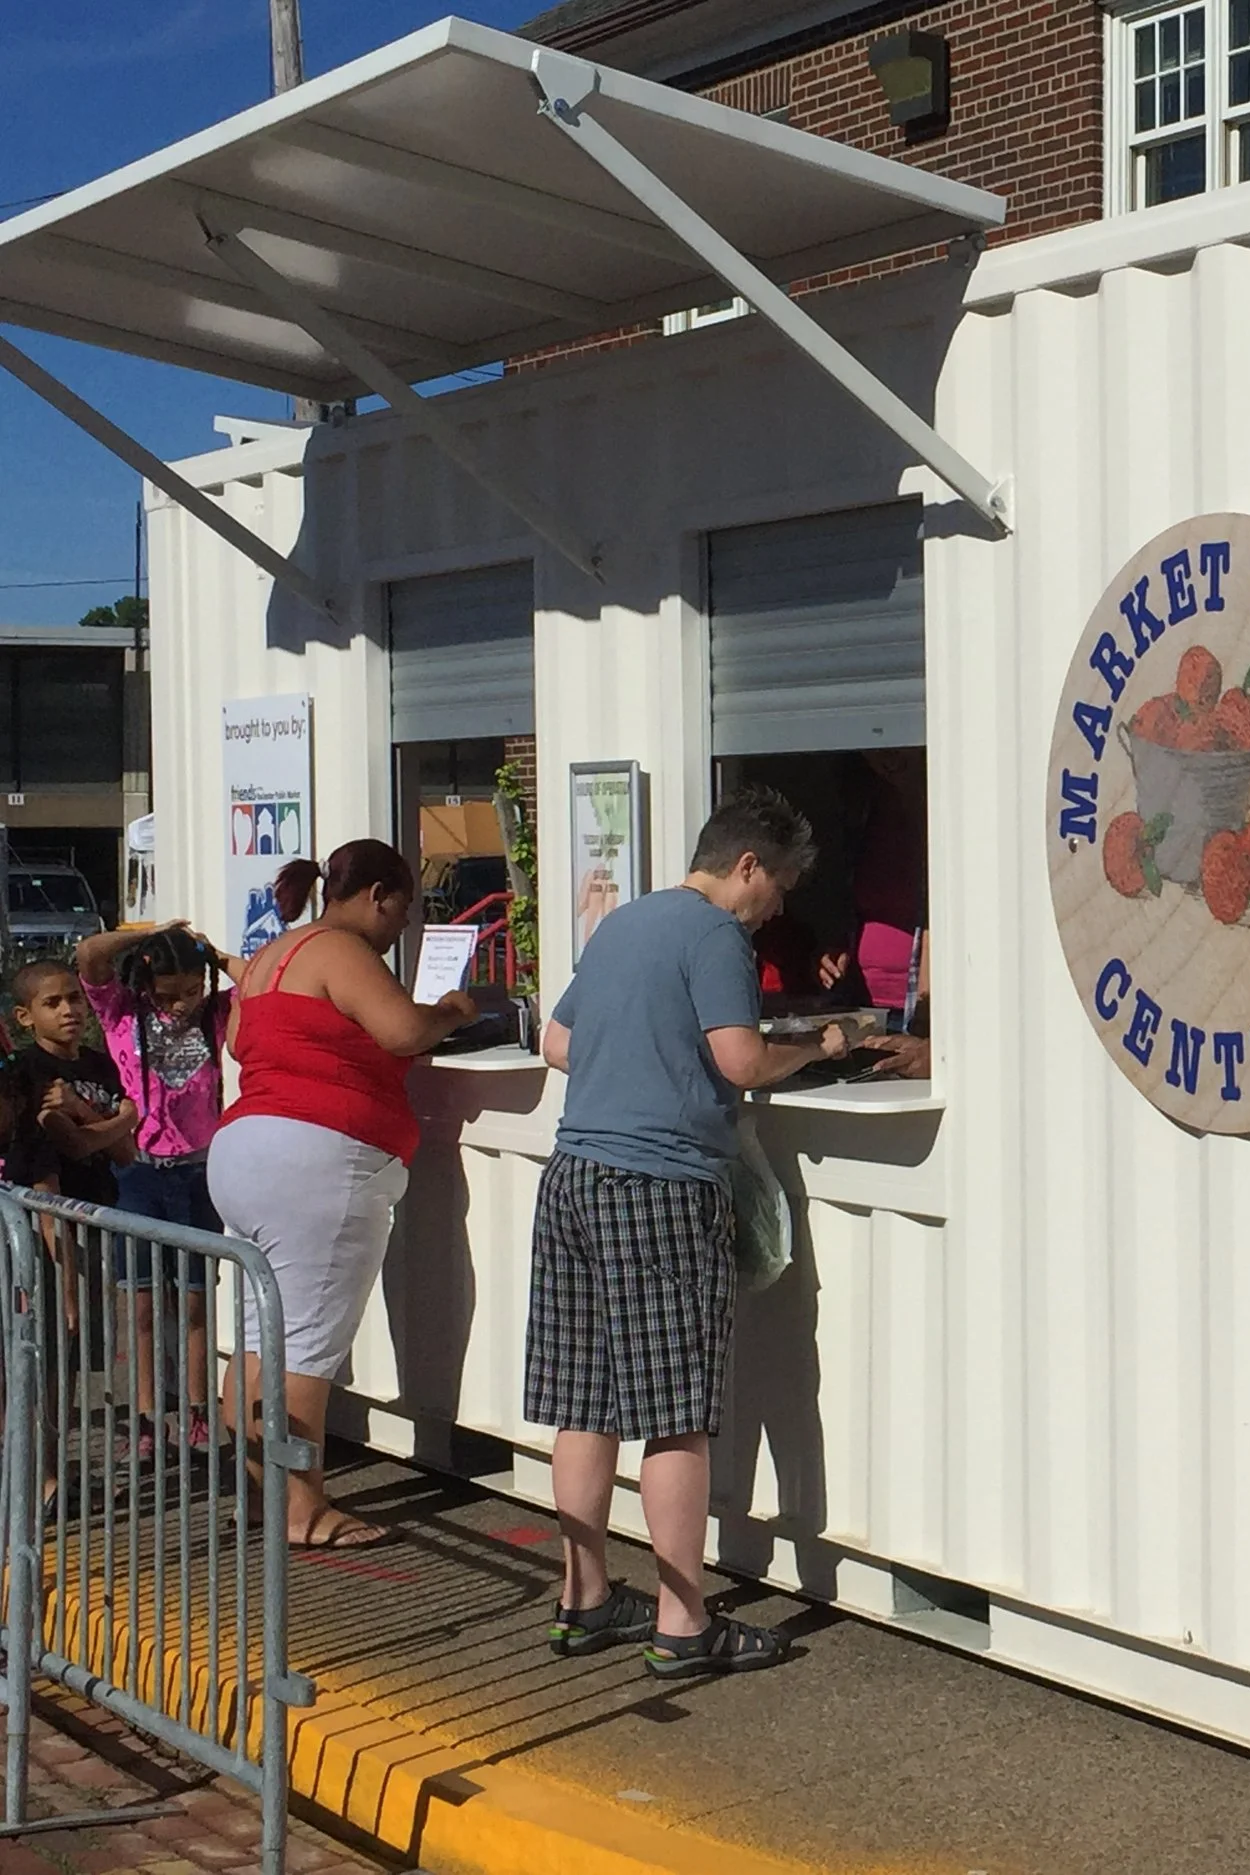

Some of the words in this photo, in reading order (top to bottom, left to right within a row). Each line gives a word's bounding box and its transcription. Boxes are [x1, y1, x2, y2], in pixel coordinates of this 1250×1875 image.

[225, 718, 259, 744] brought
[261, 718, 271, 737] to
[272, 720, 289, 741] you
[1060, 541, 1232, 844] MARKET
